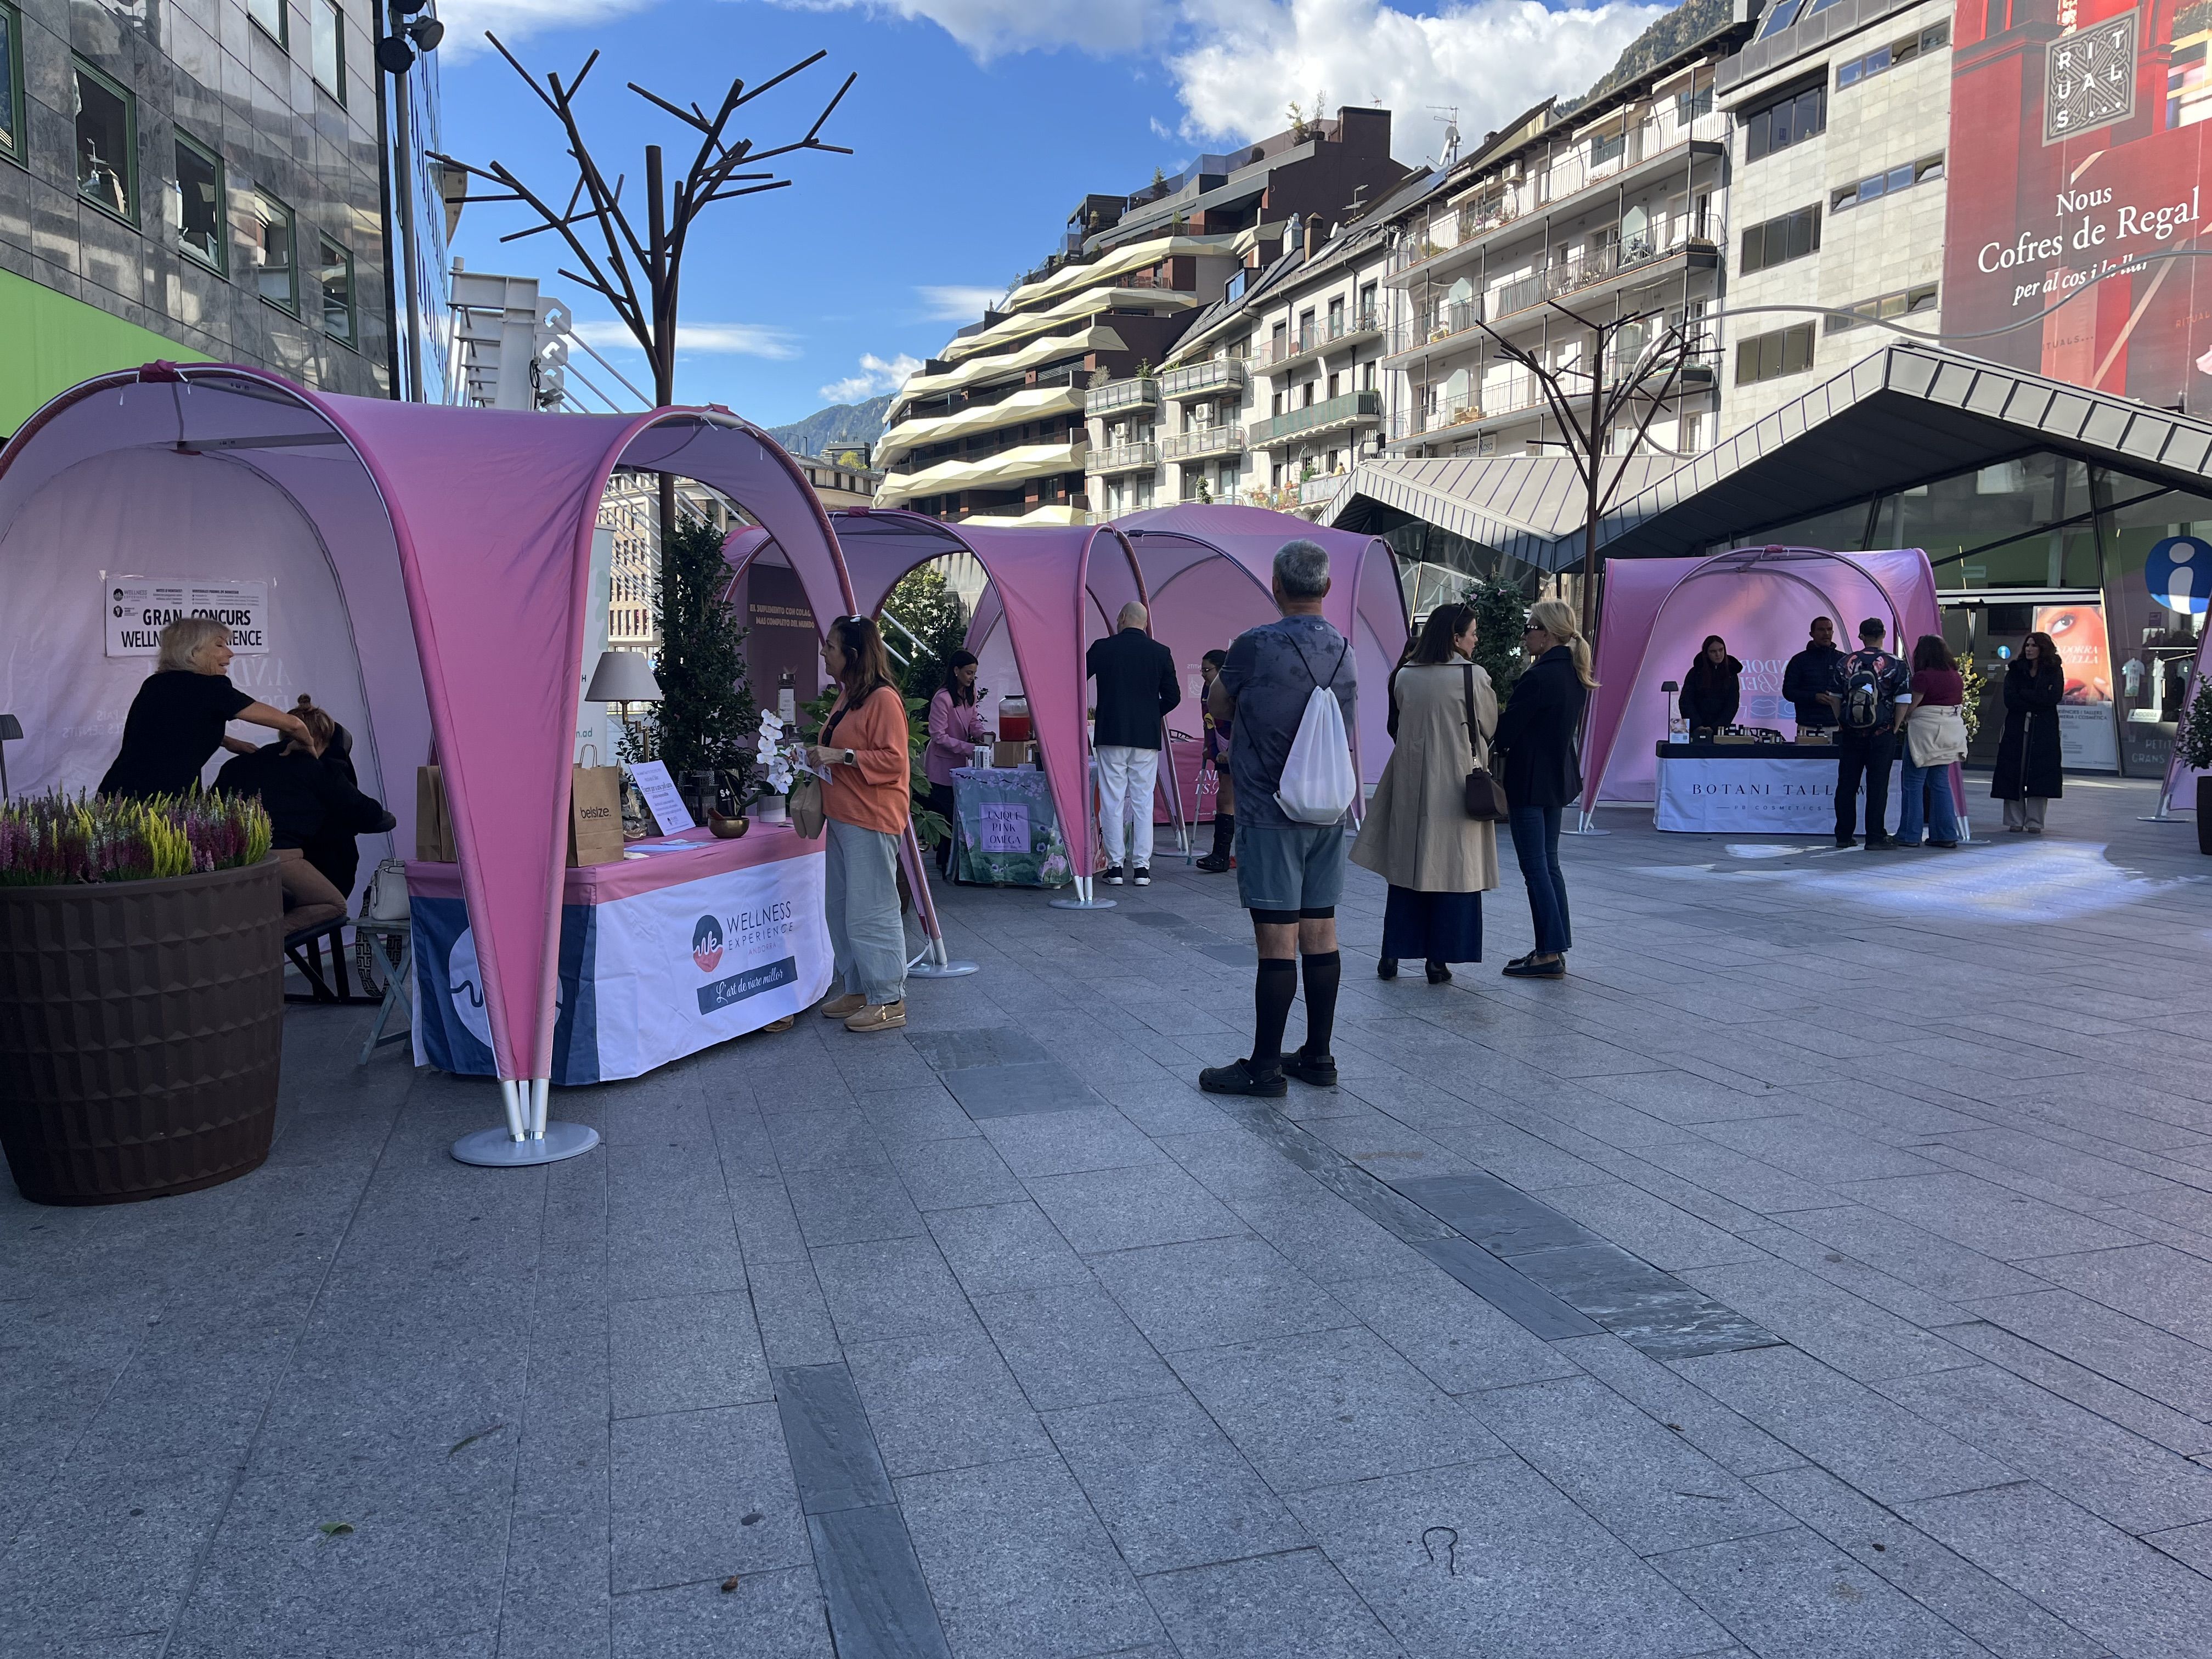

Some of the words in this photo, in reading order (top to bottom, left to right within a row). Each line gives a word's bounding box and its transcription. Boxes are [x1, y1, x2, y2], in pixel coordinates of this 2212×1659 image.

[2056, 187, 2112, 216] Nous
[1978, 232, 2063, 273] Cofres
[2073, 216, 2106, 250] de
[2116, 185, 2200, 240] Regal
[2012, 282, 2040, 306] per
[2042, 272, 2059, 293] al
[2062, 270, 2087, 289] cos
[2091, 263, 2098, 279] i
[2176, 311, 2211, 328] RITUAL
[143, 608, 182, 625] GRAN
[121, 631, 161, 647] WELLN
[575, 727, 592, 738] n.ad
[1692, 784, 1770, 795] BOTANI
[1783, 784, 1866, 796] TALLW
[988, 811, 1019, 822] UNIQUE
[992, 823, 1015, 832] PINK
[990, 834, 1021, 844] OMEGA
[726, 901, 791, 934] WELLNESS
[729, 922, 793, 951] EXPERIENCE
[748, 941, 777, 956] ANDORRA
[738, 978, 747, 992] de
[763, 966, 784, 986] millor
